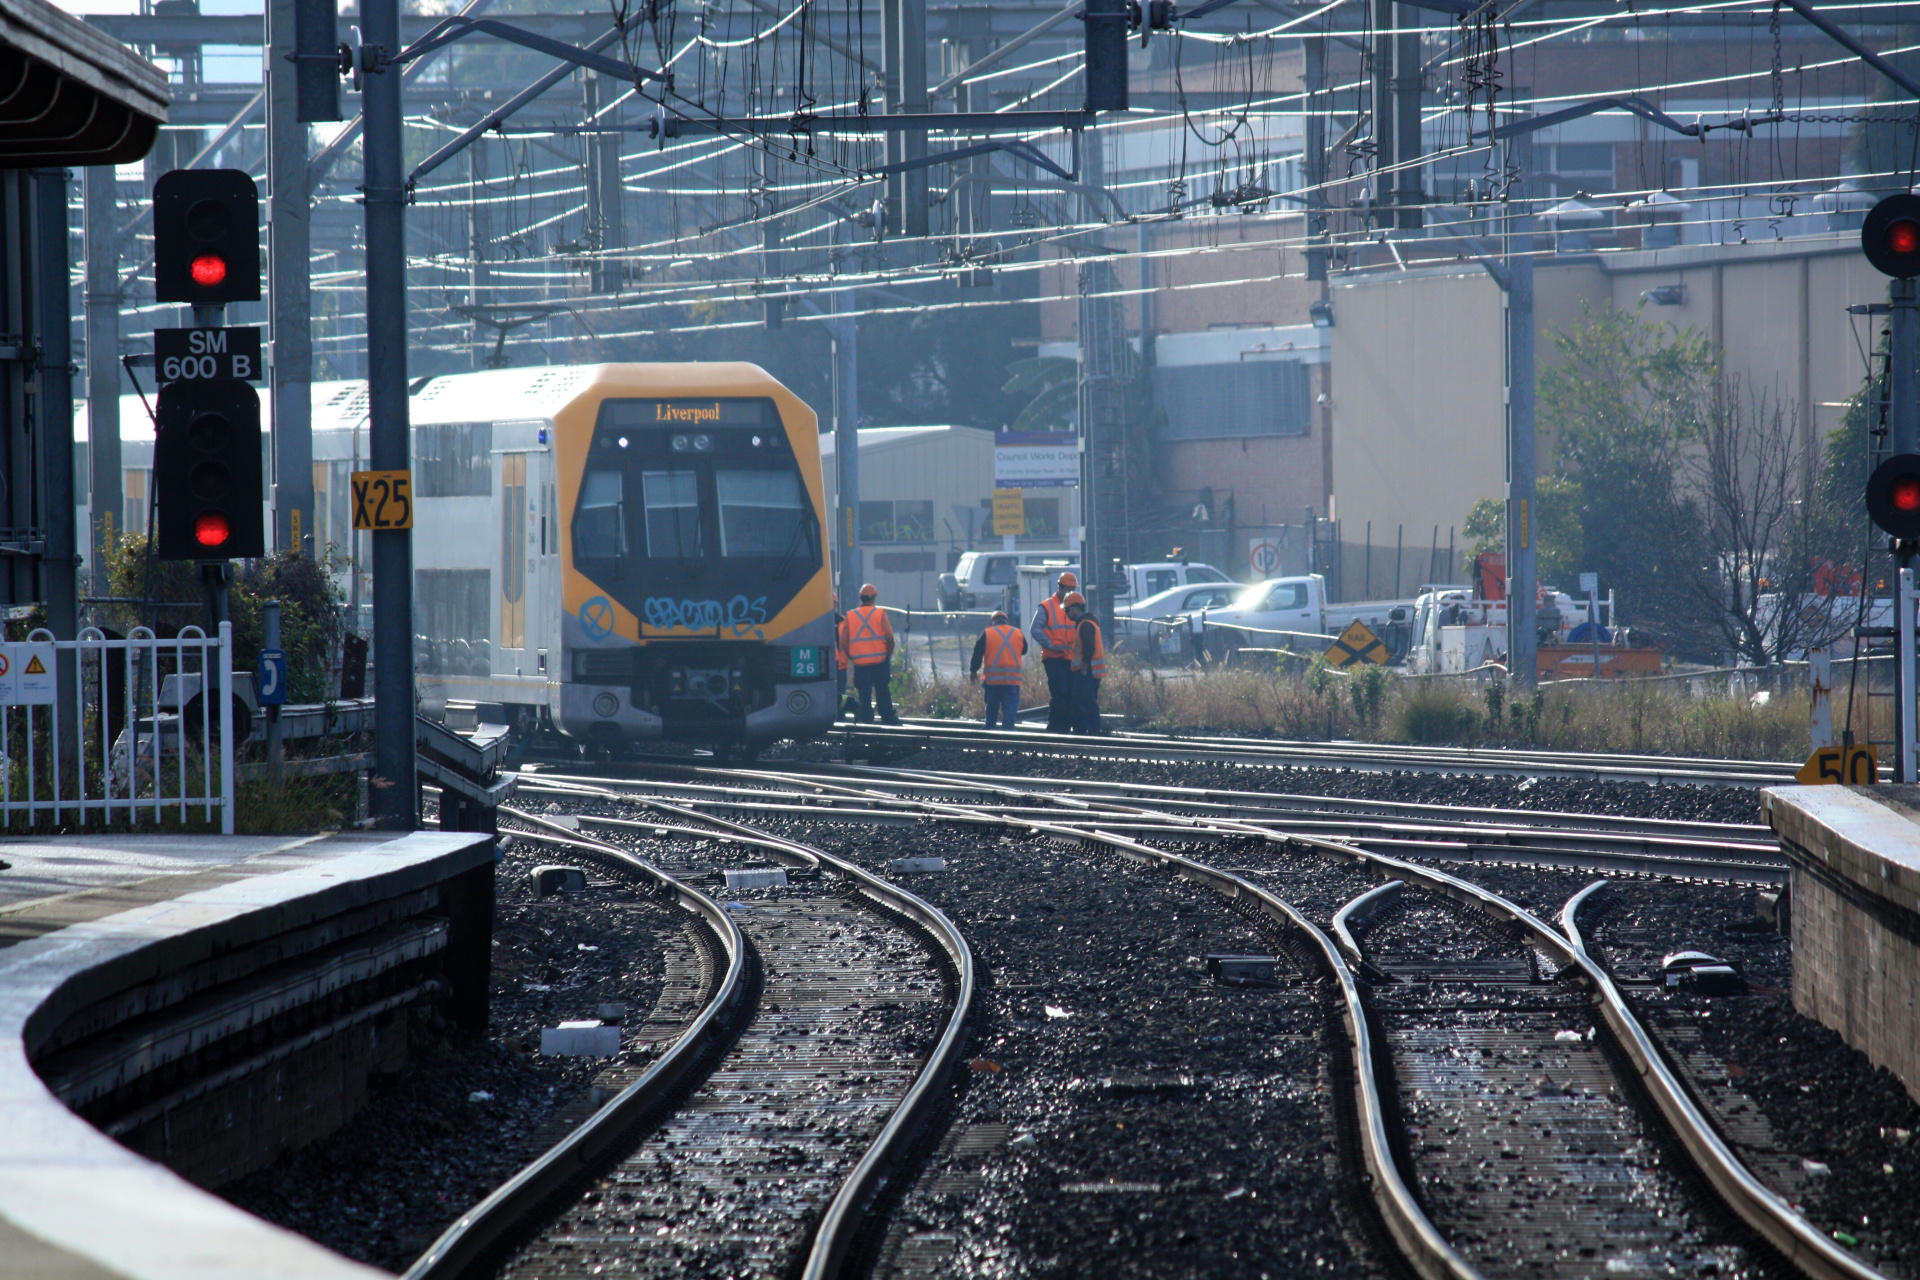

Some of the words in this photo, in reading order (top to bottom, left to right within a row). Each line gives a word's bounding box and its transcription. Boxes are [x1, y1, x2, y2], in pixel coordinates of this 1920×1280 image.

[188, 330, 227, 354] SM
[163, 355, 217, 380] 600
[232, 355, 251, 378] B
[655, 402, 720, 424] Liverpool
[997, 451, 1028, 461] Council
[1030, 451, 1056, 461] Works
[1257, 550, 1276, 567] 10
[1347, 633, 1368, 642] RAIL
[799, 648, 811, 660] M
[796, 662, 815, 674] 26
[1819, 750, 1876, 785] 50
